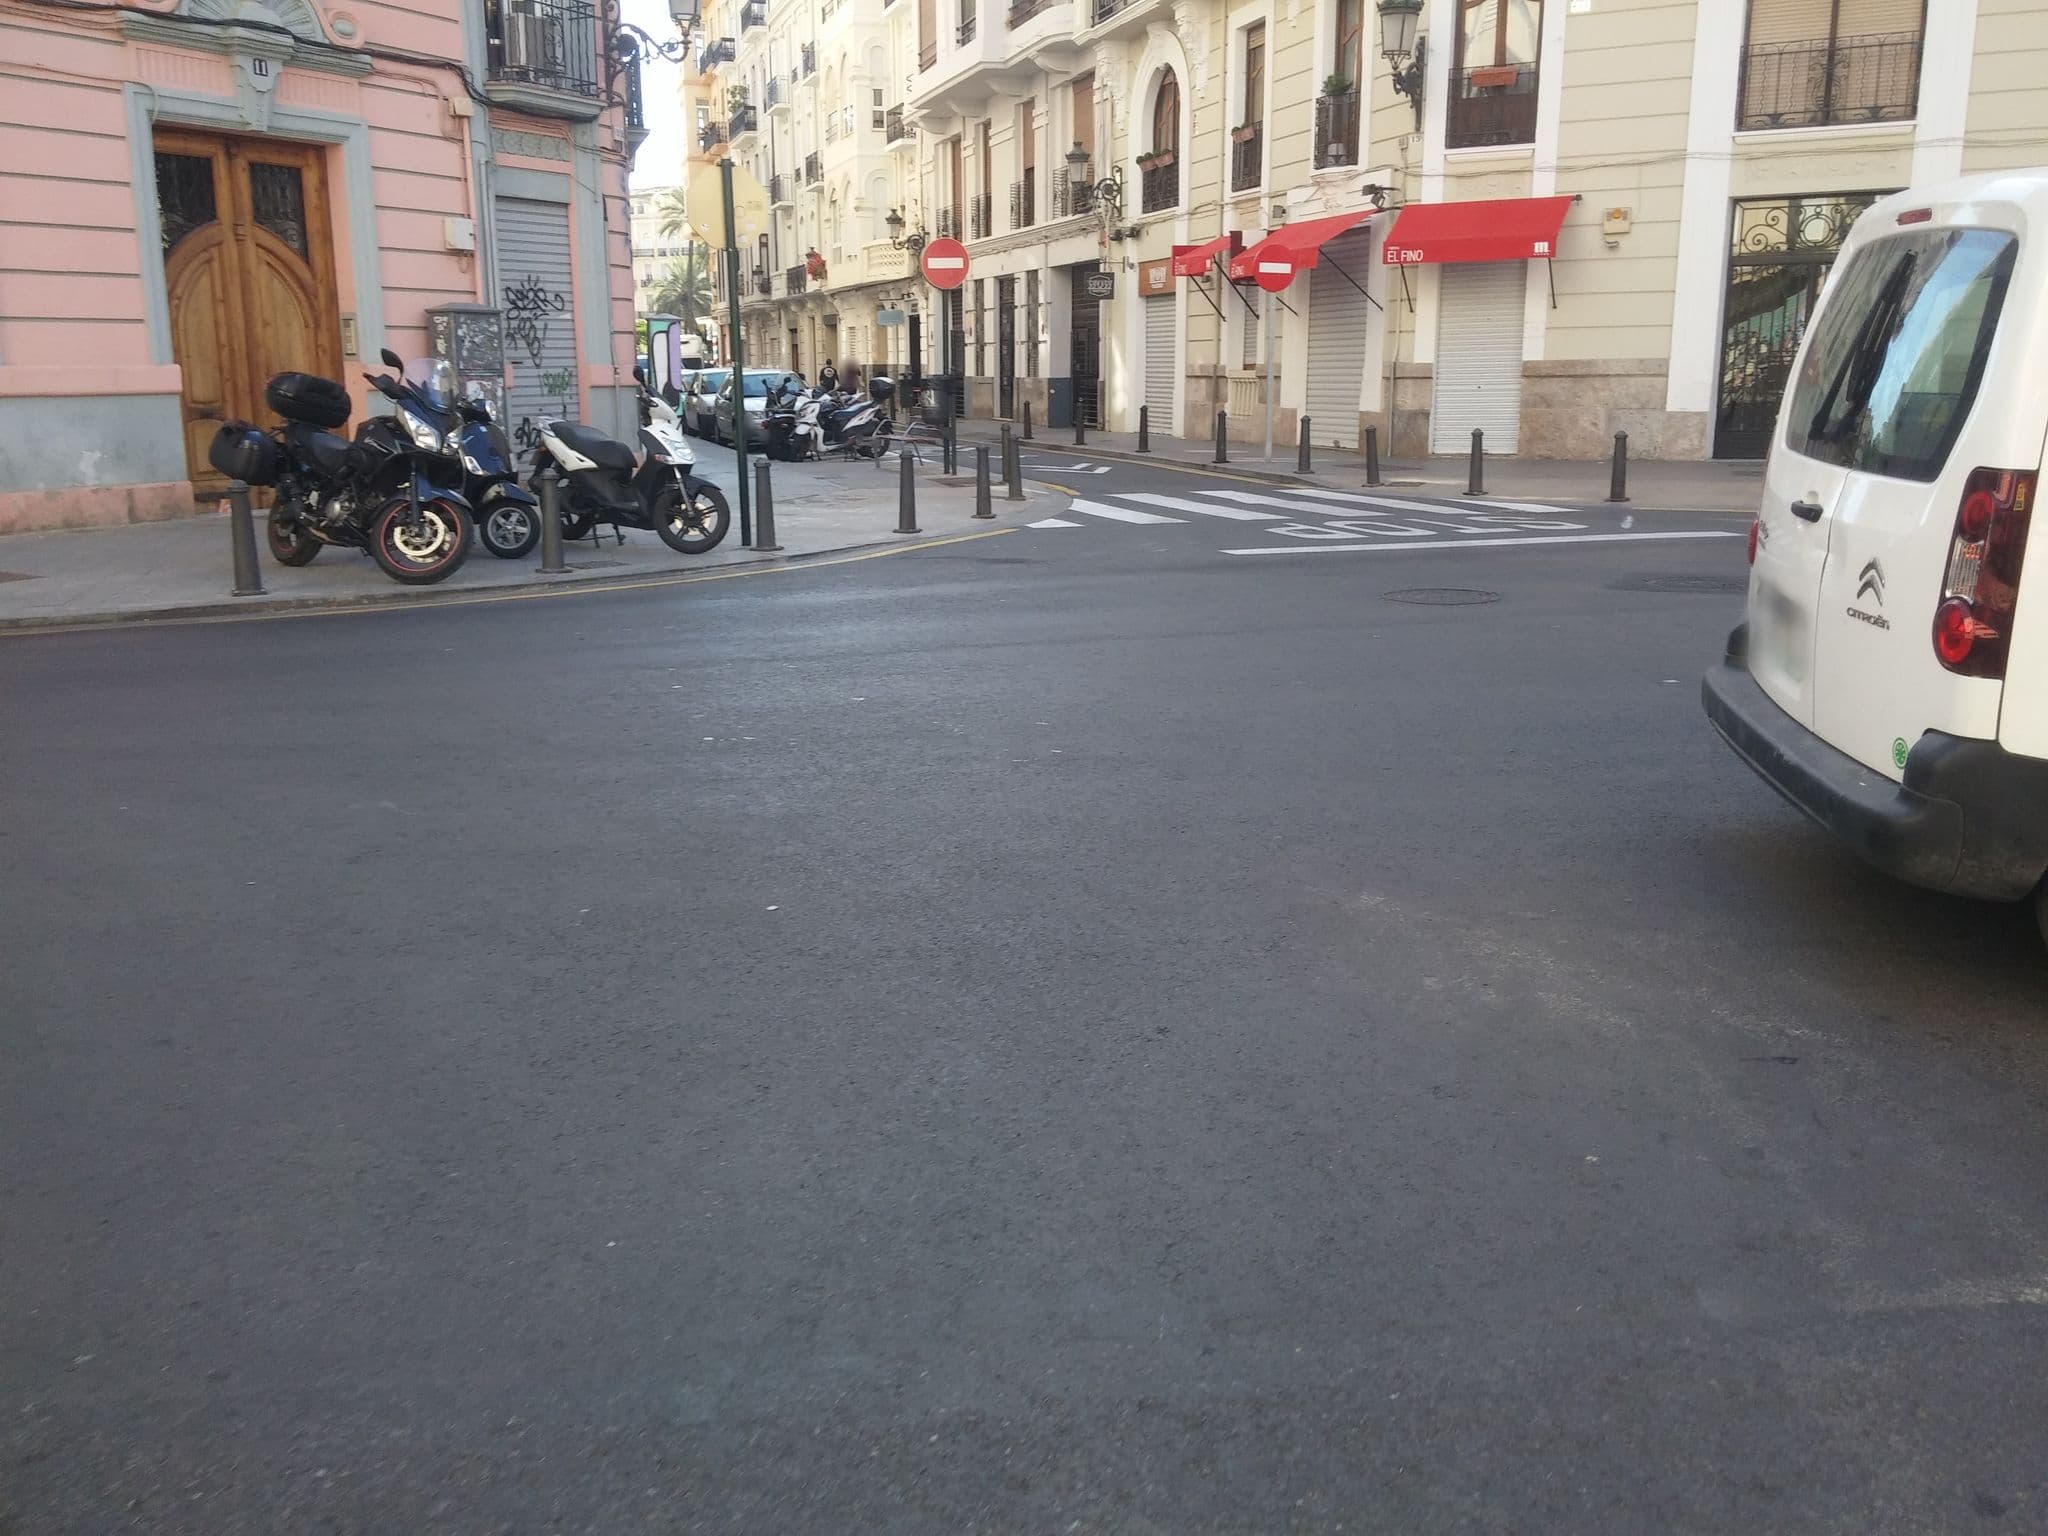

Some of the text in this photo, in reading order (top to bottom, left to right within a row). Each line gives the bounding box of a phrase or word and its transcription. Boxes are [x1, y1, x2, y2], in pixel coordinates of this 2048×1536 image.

[254, 59, 267, 75] 11
[1387, 249, 1423, 262] EL FINO
